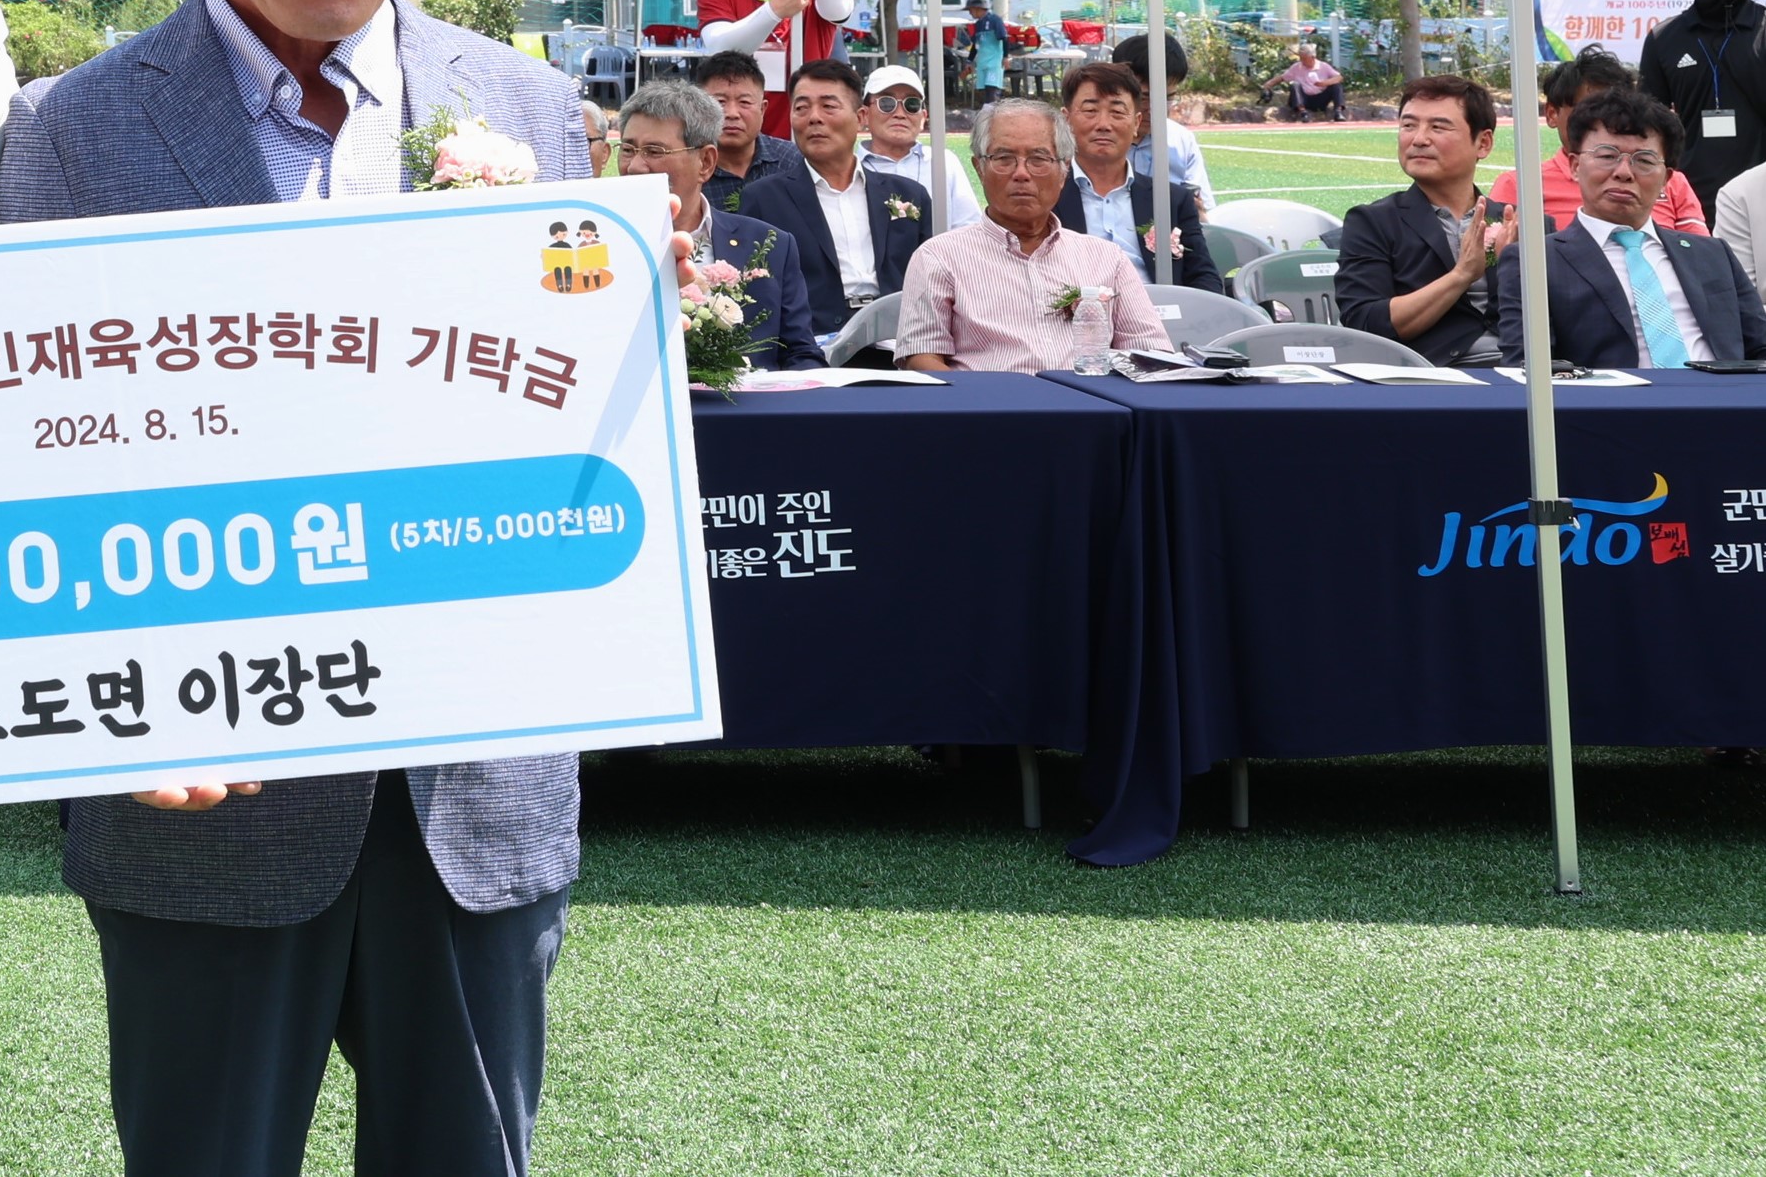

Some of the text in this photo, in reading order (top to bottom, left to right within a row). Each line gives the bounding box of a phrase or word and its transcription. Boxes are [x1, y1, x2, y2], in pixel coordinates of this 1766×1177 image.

[1565, 16, 1625, 40] 함께한
[406, 326, 578, 410] 기탁금
[34, 404, 239, 449] 2024. 8. 15.
[390, 503, 625, 553] (5차/5,000천원)
[776, 490, 832, 524] 주인
[772, 528, 857, 578] 진도
[1710, 542, 1766, 573] 살기
[178, 639, 381, 730] 이장단
